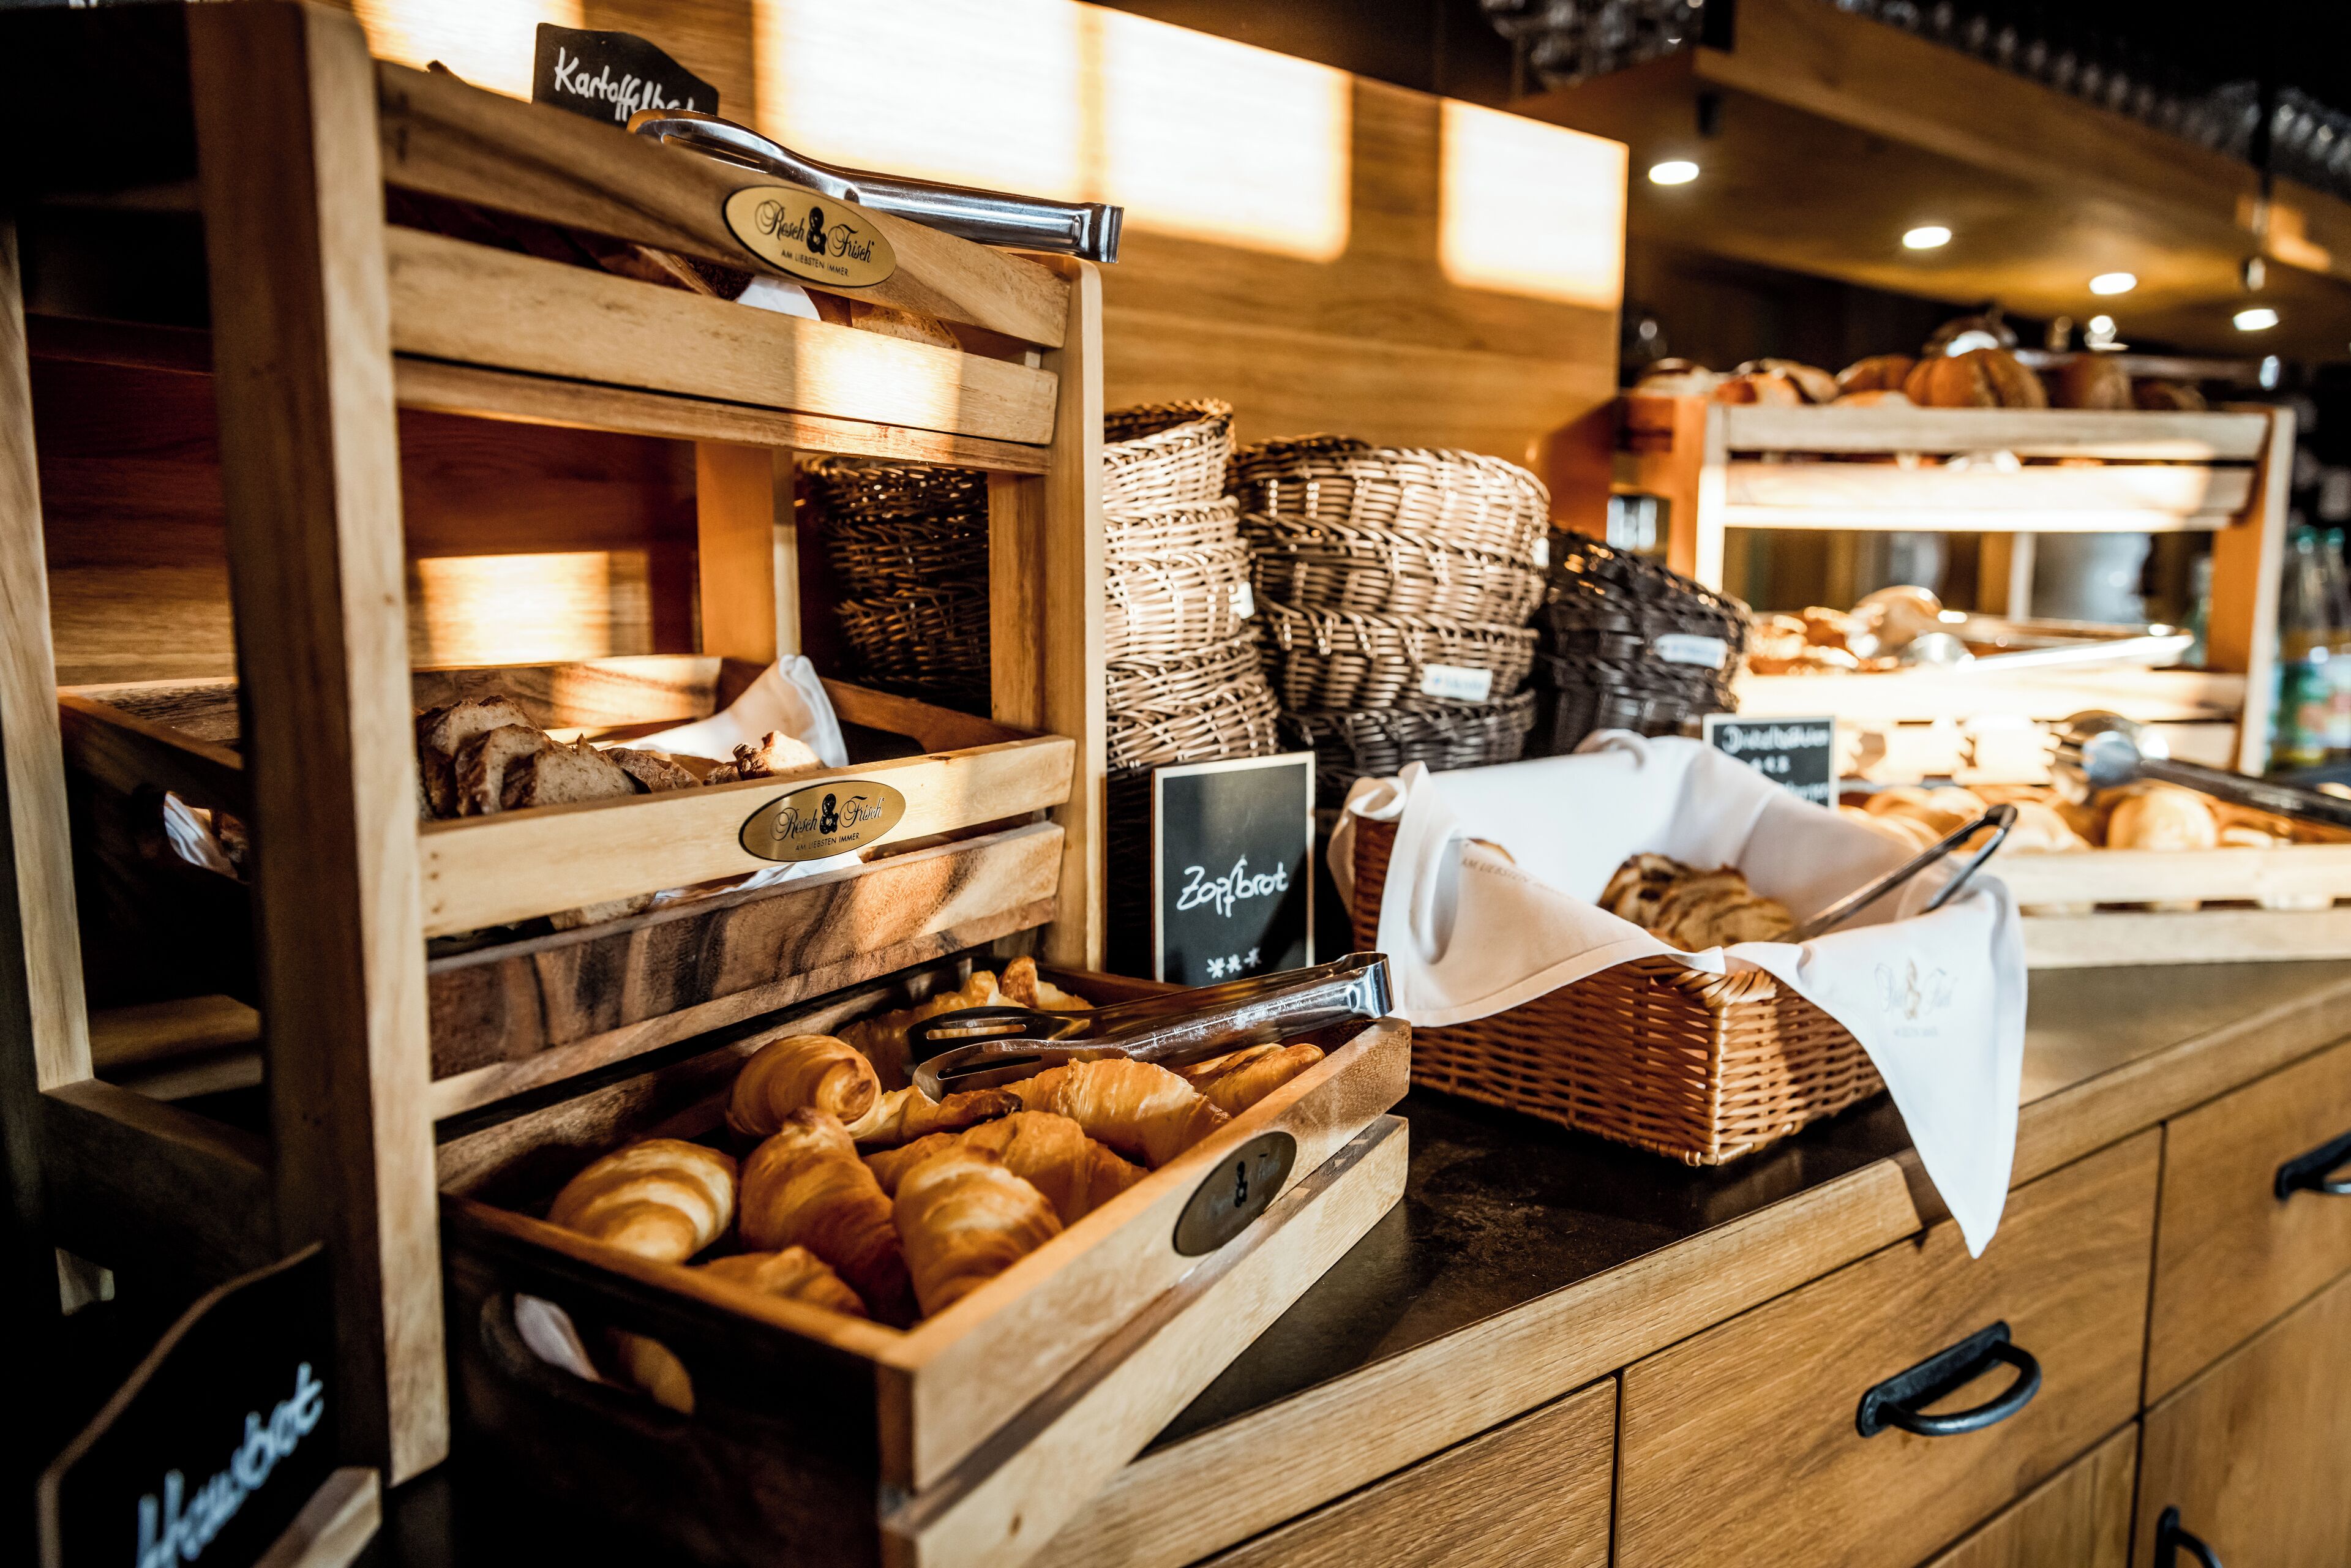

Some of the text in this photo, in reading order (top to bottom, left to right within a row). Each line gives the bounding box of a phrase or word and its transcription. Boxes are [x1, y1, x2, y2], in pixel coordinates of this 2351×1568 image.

[781, 249, 850, 277] AM LIEBSTEN IMMER.
[808, 837, 837, 850] LIEBSTEN
[839, 832, 861, 843] IMMER.
[1176, 855, 1289, 918] Zopfbrot
